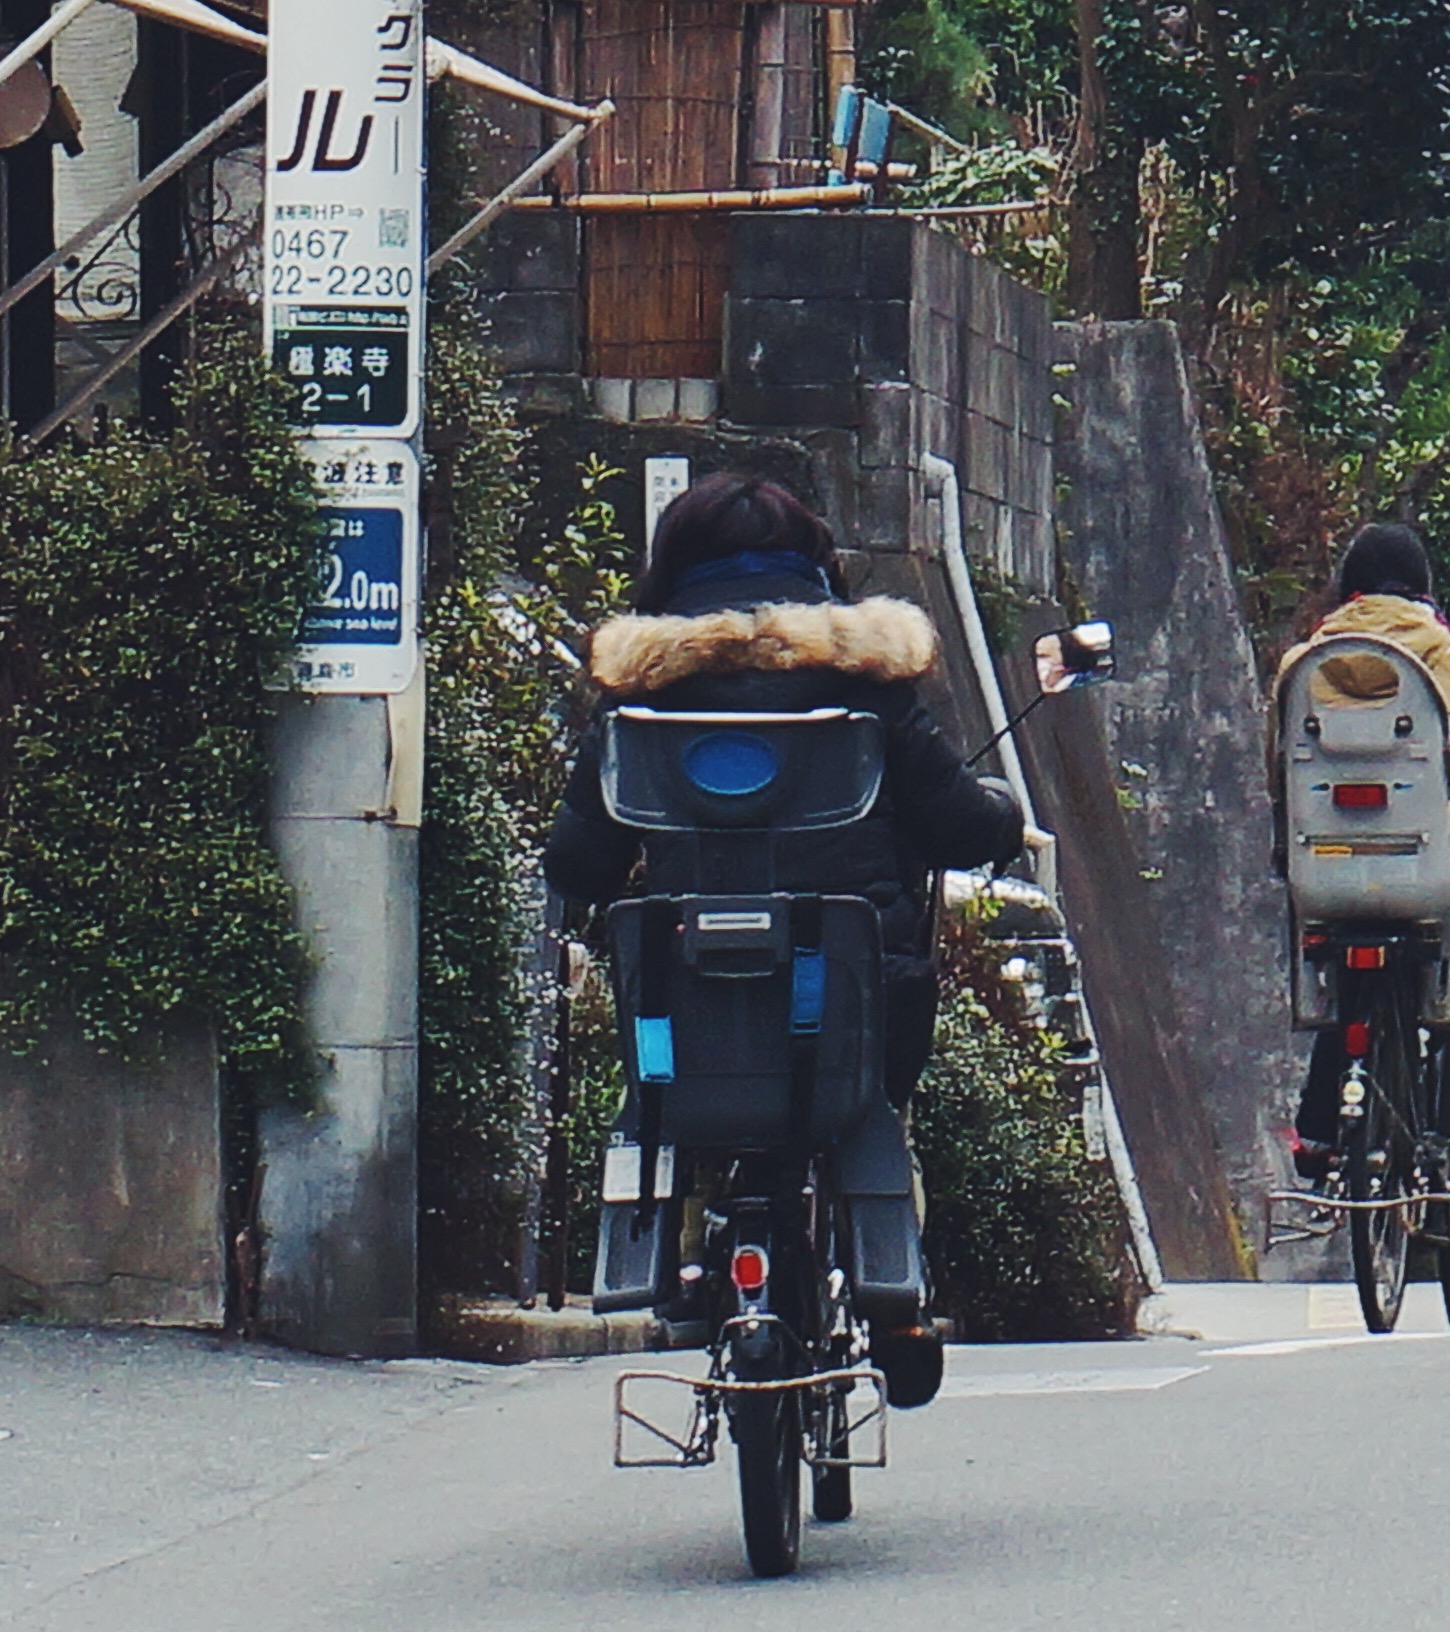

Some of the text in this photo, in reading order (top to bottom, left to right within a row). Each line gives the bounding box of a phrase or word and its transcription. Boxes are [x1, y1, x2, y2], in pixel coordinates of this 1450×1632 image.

[272, 229, 349, 260] 0467
[271, 265, 413, 297] 22-2230
[289, 345, 391, 377] 極楽寺
[302, 382, 372, 413] 2-1
